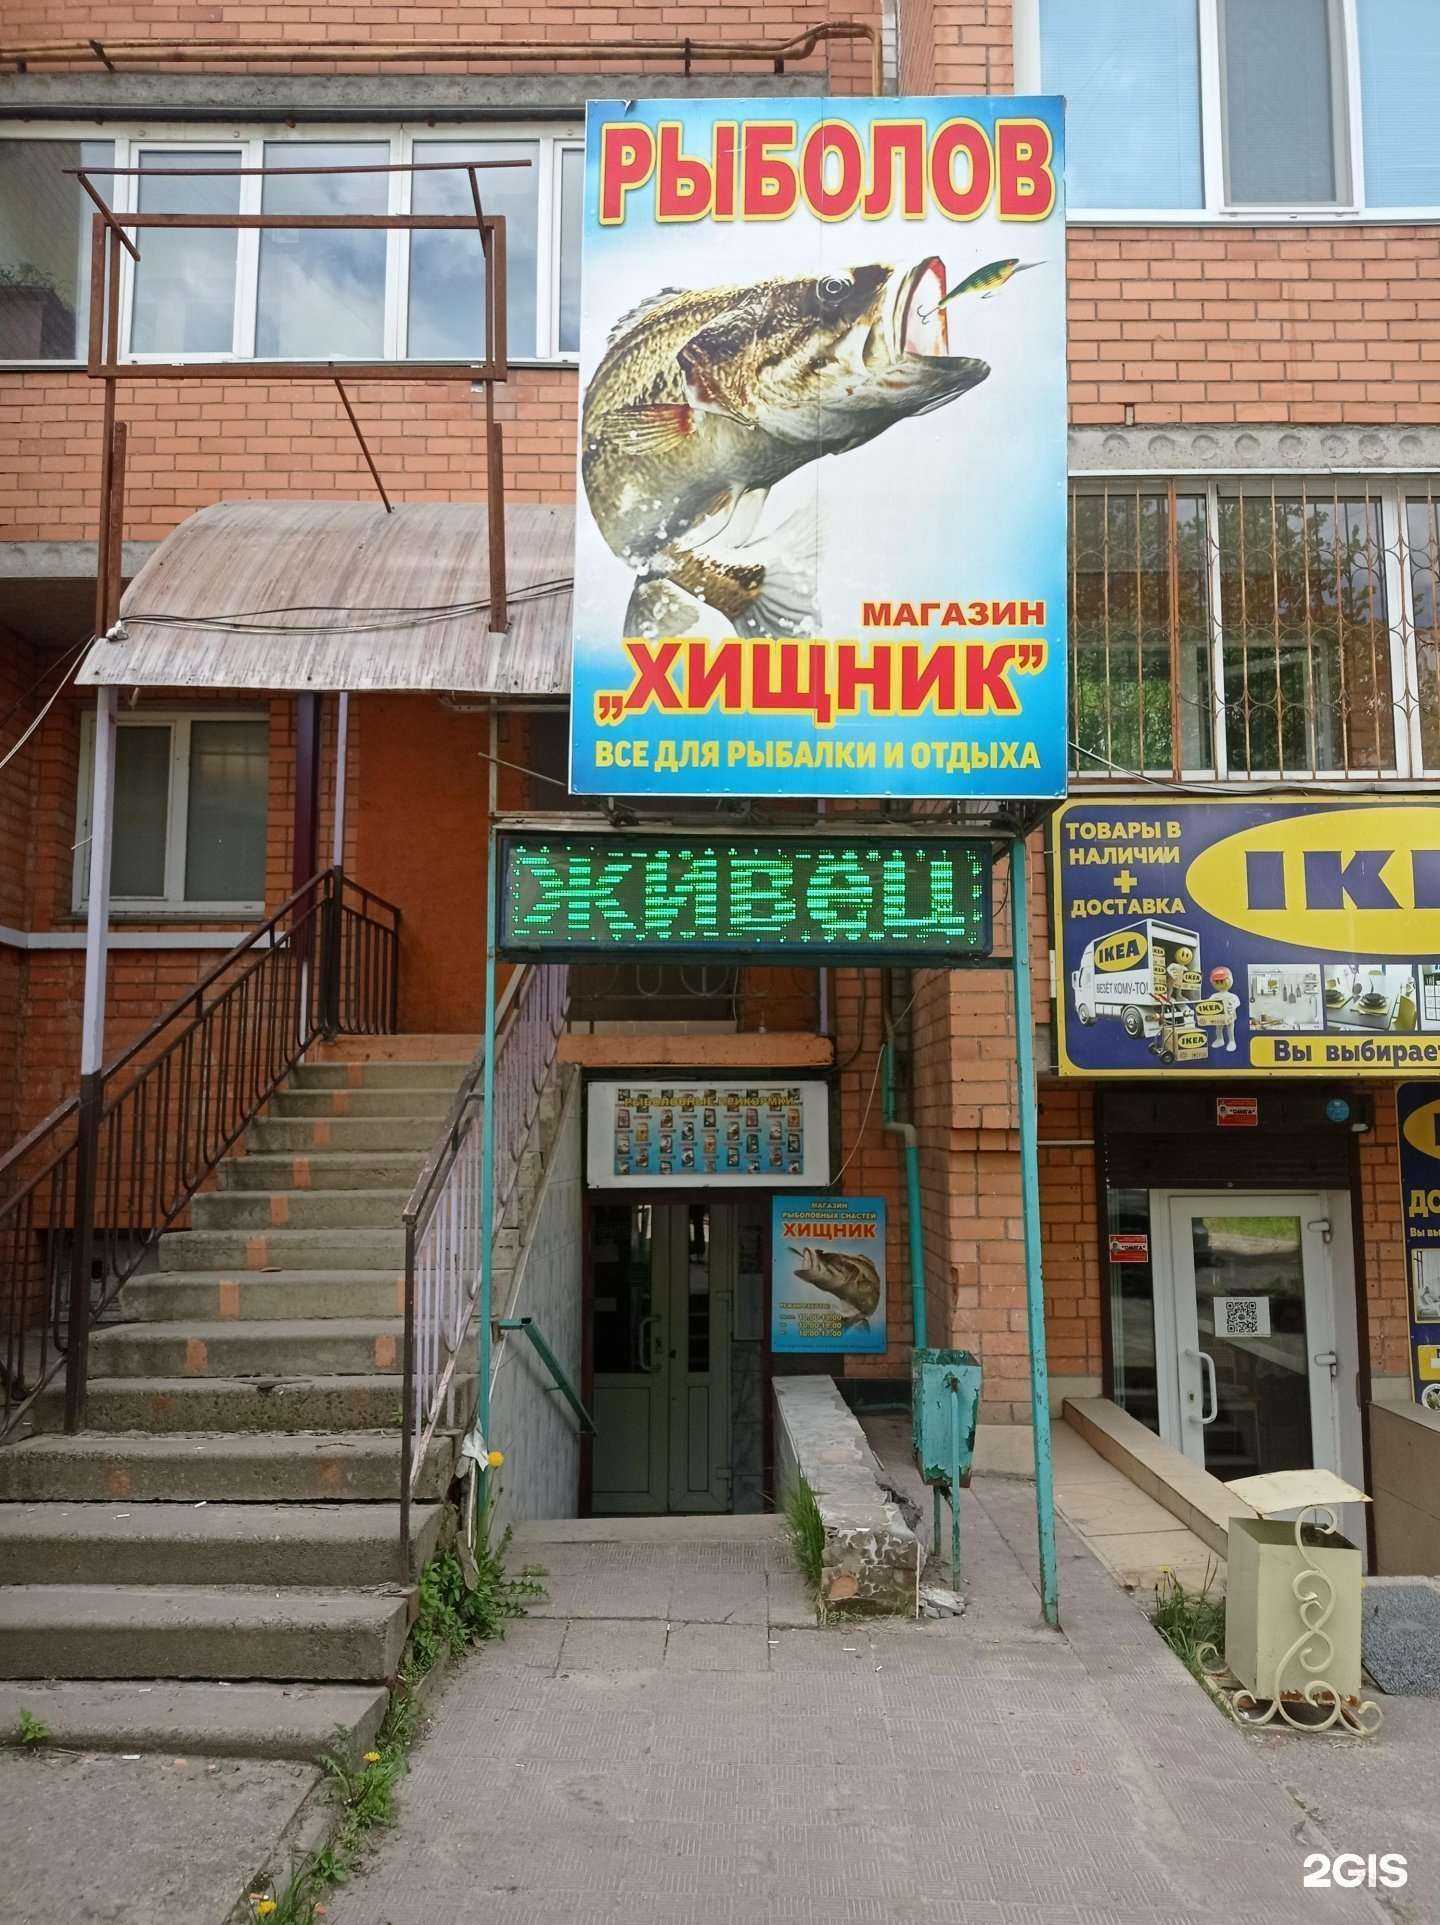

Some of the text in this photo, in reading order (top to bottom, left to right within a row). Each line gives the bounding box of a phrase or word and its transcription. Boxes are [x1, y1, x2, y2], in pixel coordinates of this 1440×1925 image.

[599, 117, 1056, 225] РЫБОЛОВ
[863, 601, 1045, 627] МАГАЗИН
[595, 740, 1042, 774] ВСЕ ДЛЯ РЫБАЛКИ И ОТДЫХА
[1066, 821, 1182, 841] ТОВАРЫ В
[1069, 846, 1181, 866] НАЛИЧИИ
[1071, 898, 1186, 918] ДОСТАВКА
[1099, 939, 1141, 963] IKEA
[1181, 1036, 1205, 1045] IKEA
[1273, 1039, 1440, 1069] Вы выбирае
[783, 1223, 876, 1240] ХИЩНИК
